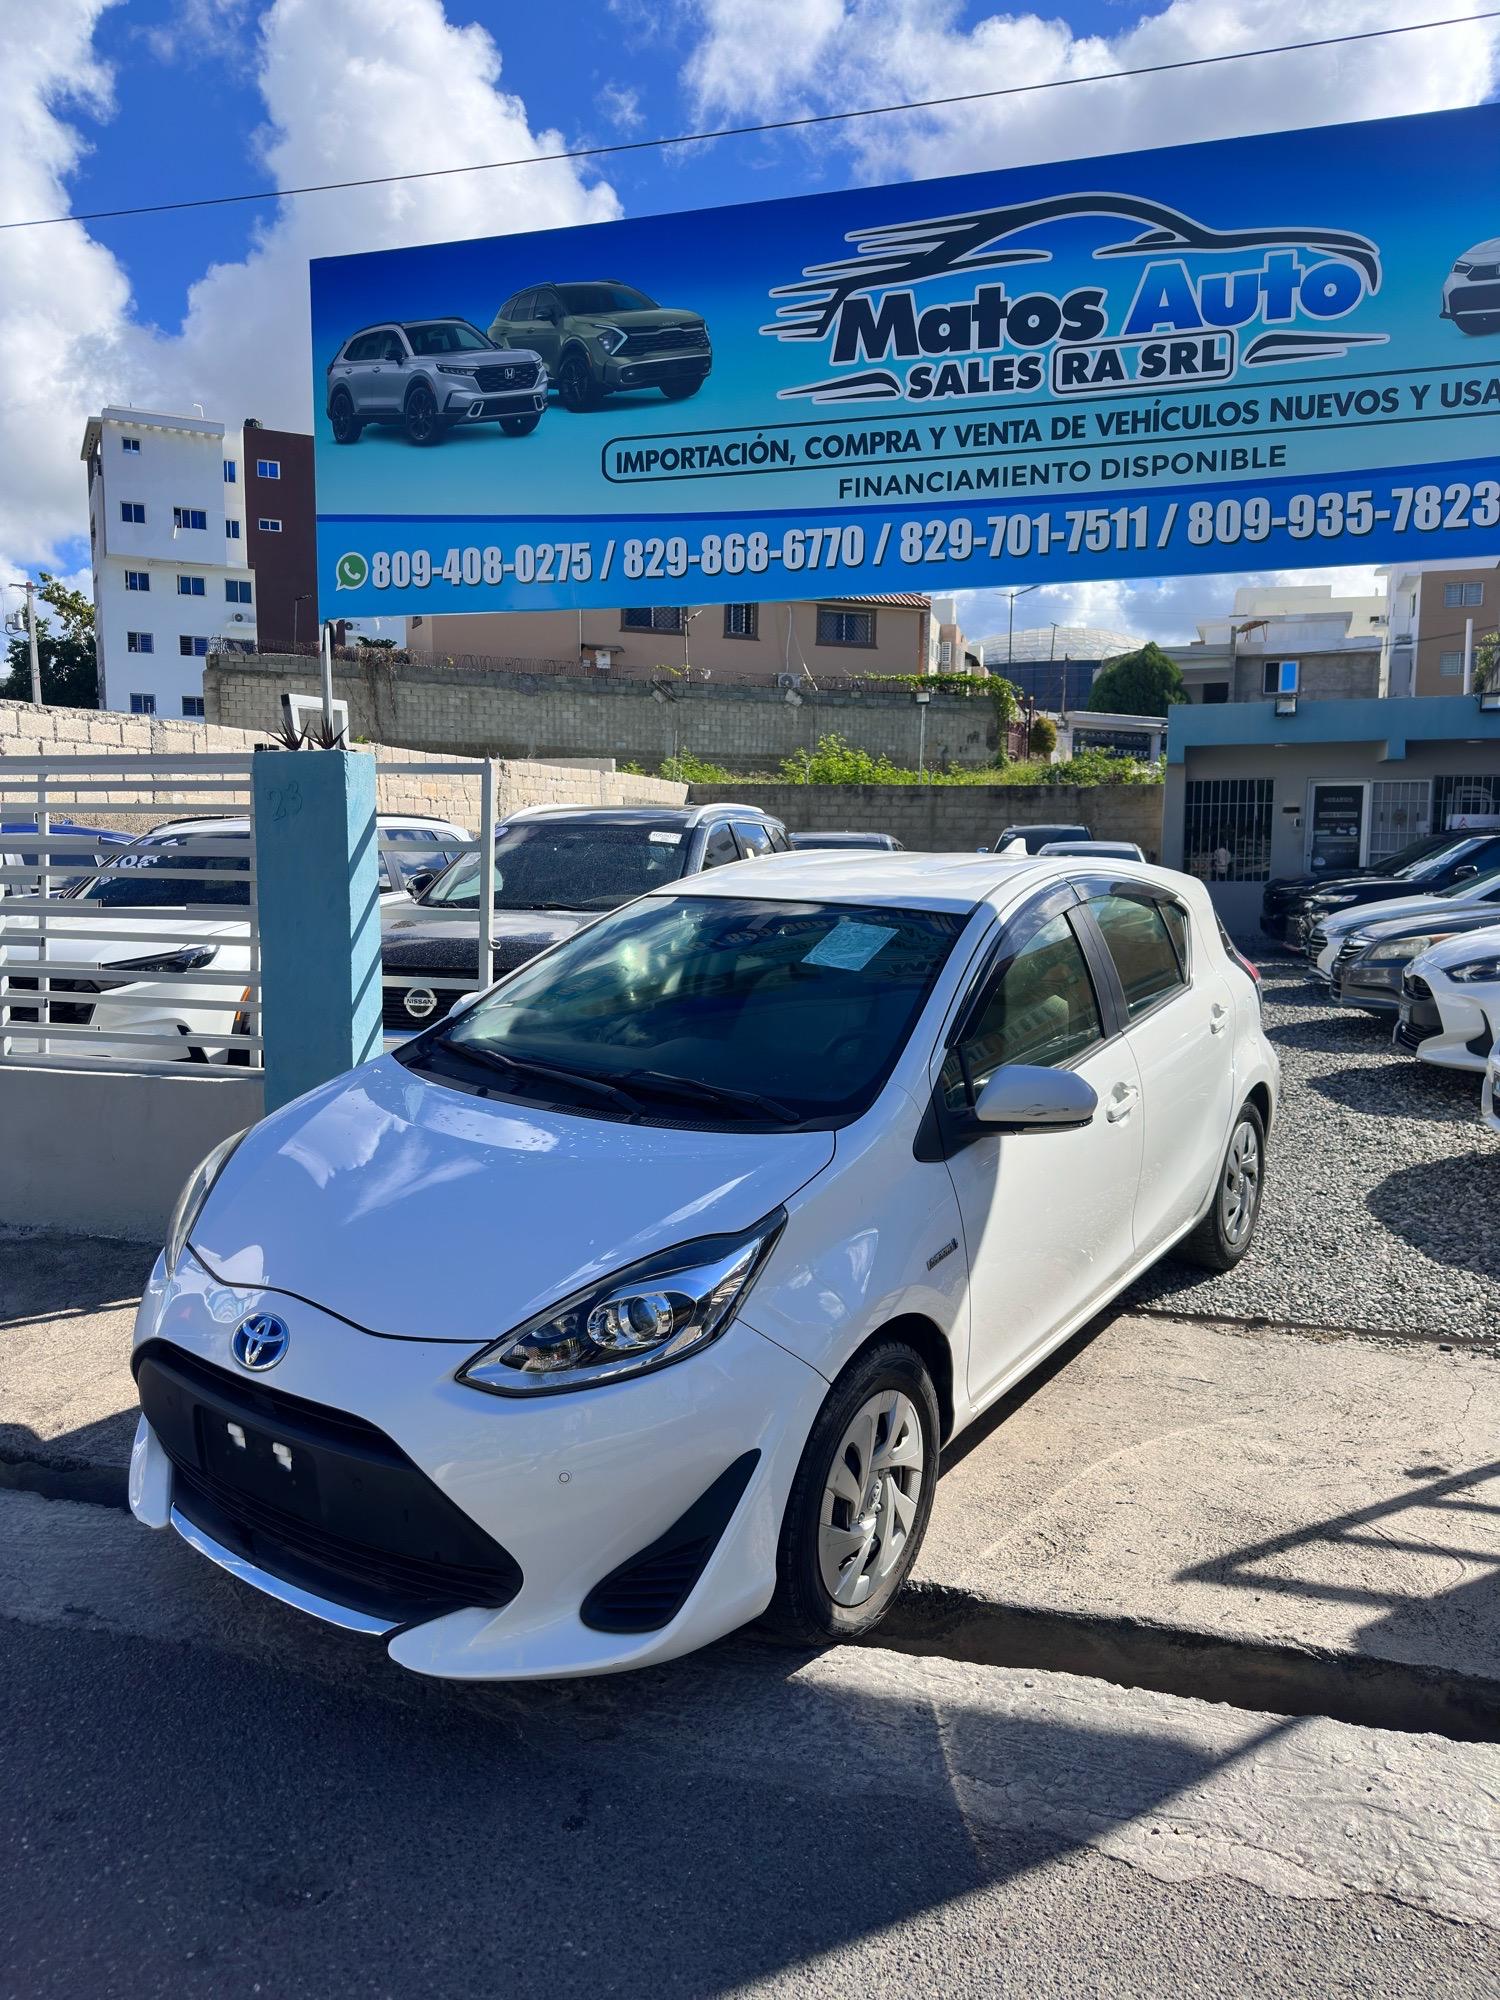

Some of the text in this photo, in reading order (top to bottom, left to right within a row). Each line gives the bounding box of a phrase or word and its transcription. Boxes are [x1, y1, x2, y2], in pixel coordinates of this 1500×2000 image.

[831, 251, 1363, 364] Matos Auto
[908, 337, 1227, 399] SALES RA SRL
[615, 432, 797, 475] IMPORTACIÓN,
[805, 429, 920, 460] COMPRA
[929, 426, 947, 450] Y
[954, 417, 1042, 448] VENTA
[1052, 414, 1087, 441] DE
[1096, 399, 1259, 437] VEHÍCULOS
[1271, 387, 1400, 422] NUEVOS
[1409, 384, 1431, 411] Y
[838, 444, 1287, 499] FINANCIAMIENTO DISPONIBLE
[372, 543, 592, 588] 809-408-0275
[623, 526, 864, 578] 829-868-6770
[900, 506, 1148, 564] 829-701-7511
[1187, 480, 1500, 546] 809-935-7823
